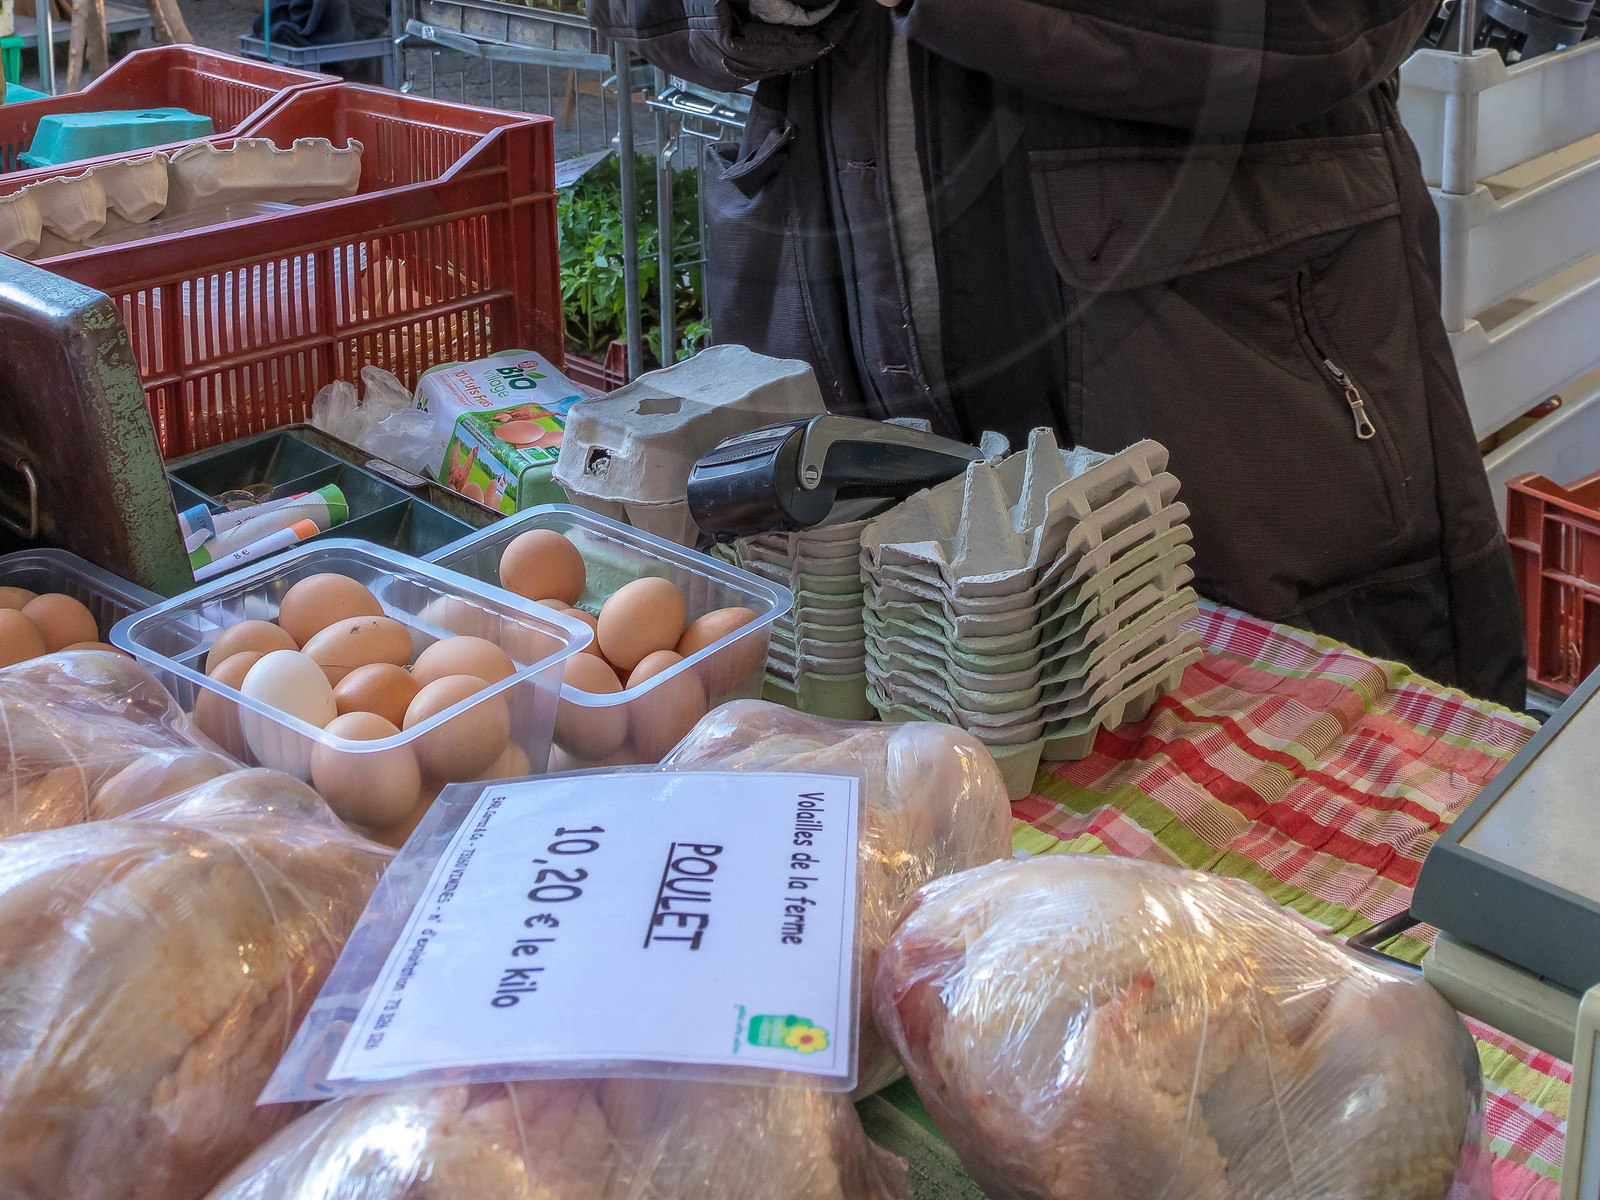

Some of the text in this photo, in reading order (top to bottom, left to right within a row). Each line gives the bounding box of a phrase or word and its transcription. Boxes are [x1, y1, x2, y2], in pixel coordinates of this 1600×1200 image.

[496, 367, 537, 390] BIO
[491, 826, 605, 1008] 10,20 € le kilo
[653, 843, 723, 951] POULET
[781, 793, 824, 945] Volailles de la ferme
